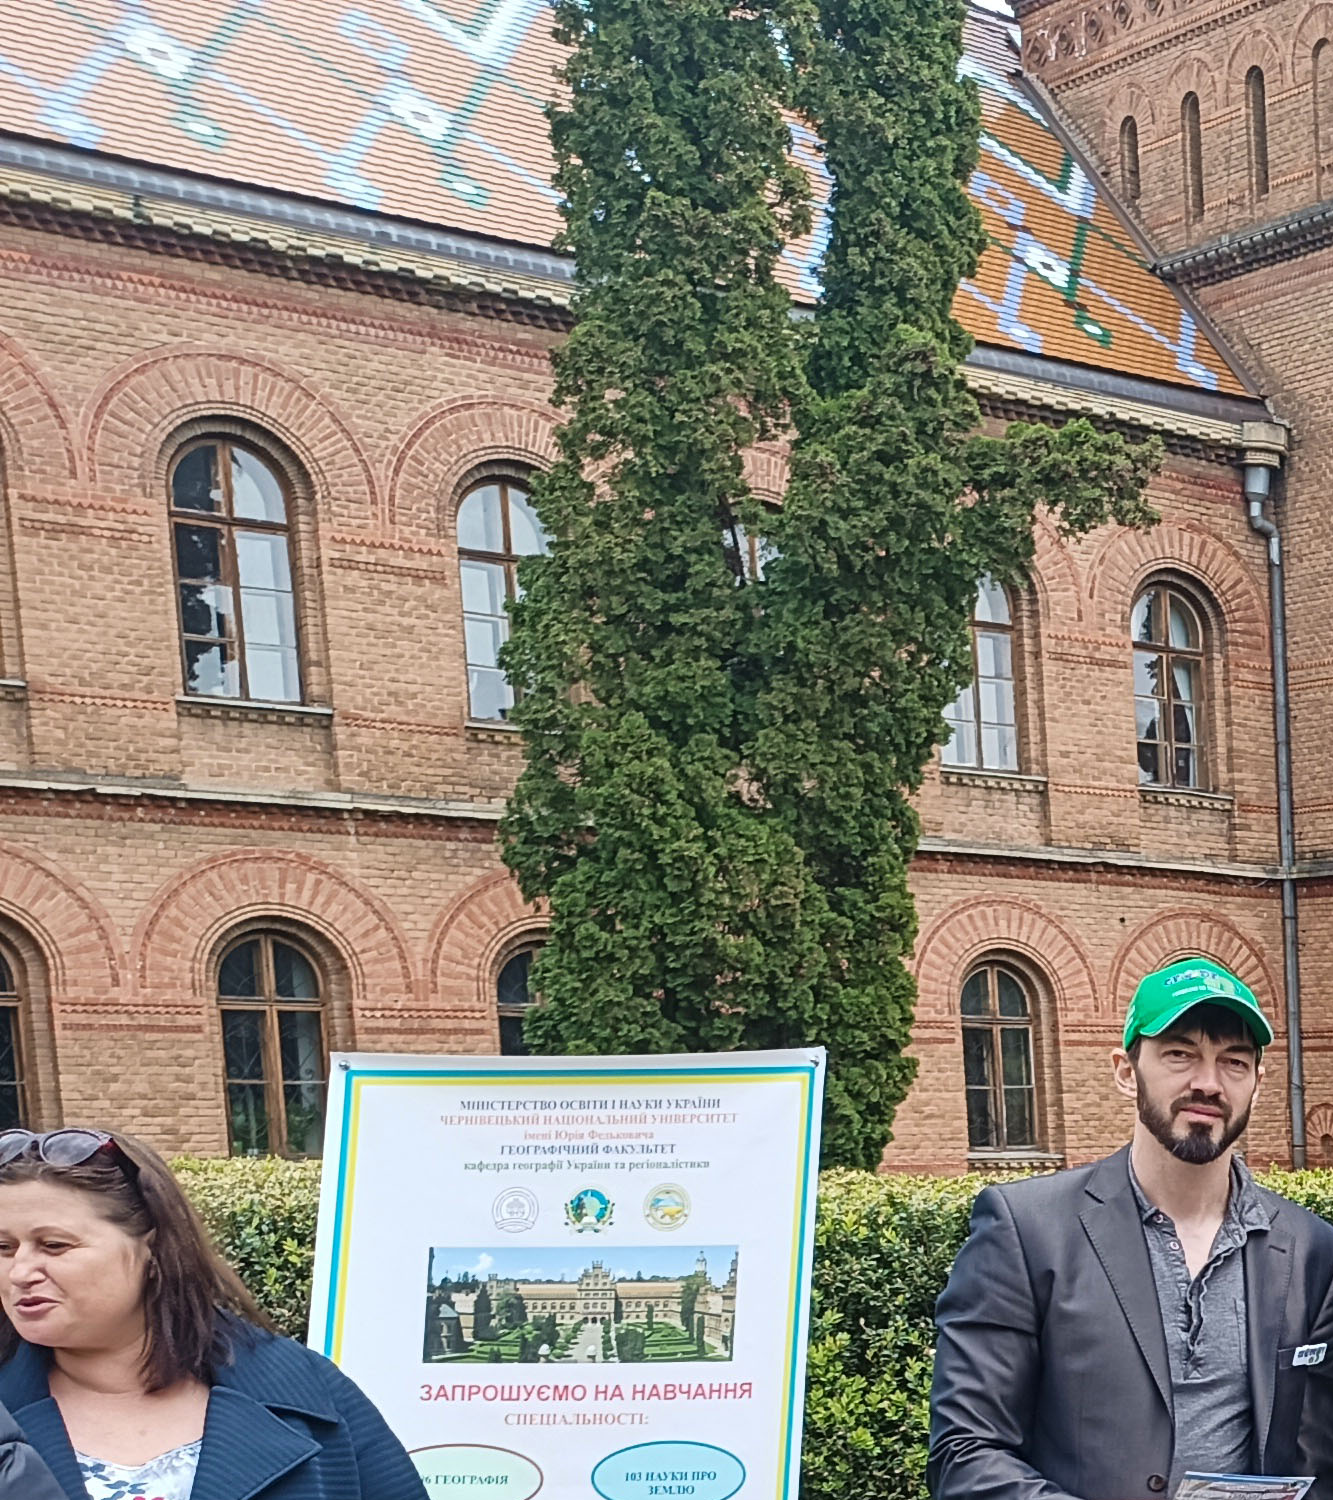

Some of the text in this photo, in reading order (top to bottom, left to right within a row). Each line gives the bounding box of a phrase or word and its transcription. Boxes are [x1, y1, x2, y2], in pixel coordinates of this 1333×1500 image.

[560, 1099, 608, 1110] ОСВІТИ
[619, 1098, 663, 1110] НАУКИ
[650, 1112, 739, 1124] УНІВЕРСИТЕТ
[499, 1142, 677, 1155] ГЕОГРАФІЧНИЙ ФАКУЛЬТЕТ
[419, 1382, 753, 1402] ЗАПРОШУЄМО НА НАВЧАННЯ
[504, 1412, 649, 1427] СПЕЦІАЛЬНОСТІ:
[434, 1474, 509, 1486] ГЕОГРАФІЯ
[624, 1471, 717, 1483] 103 НАУКИ ПРО
[648, 1484, 695, 1496] ЗЕМЛЮ
